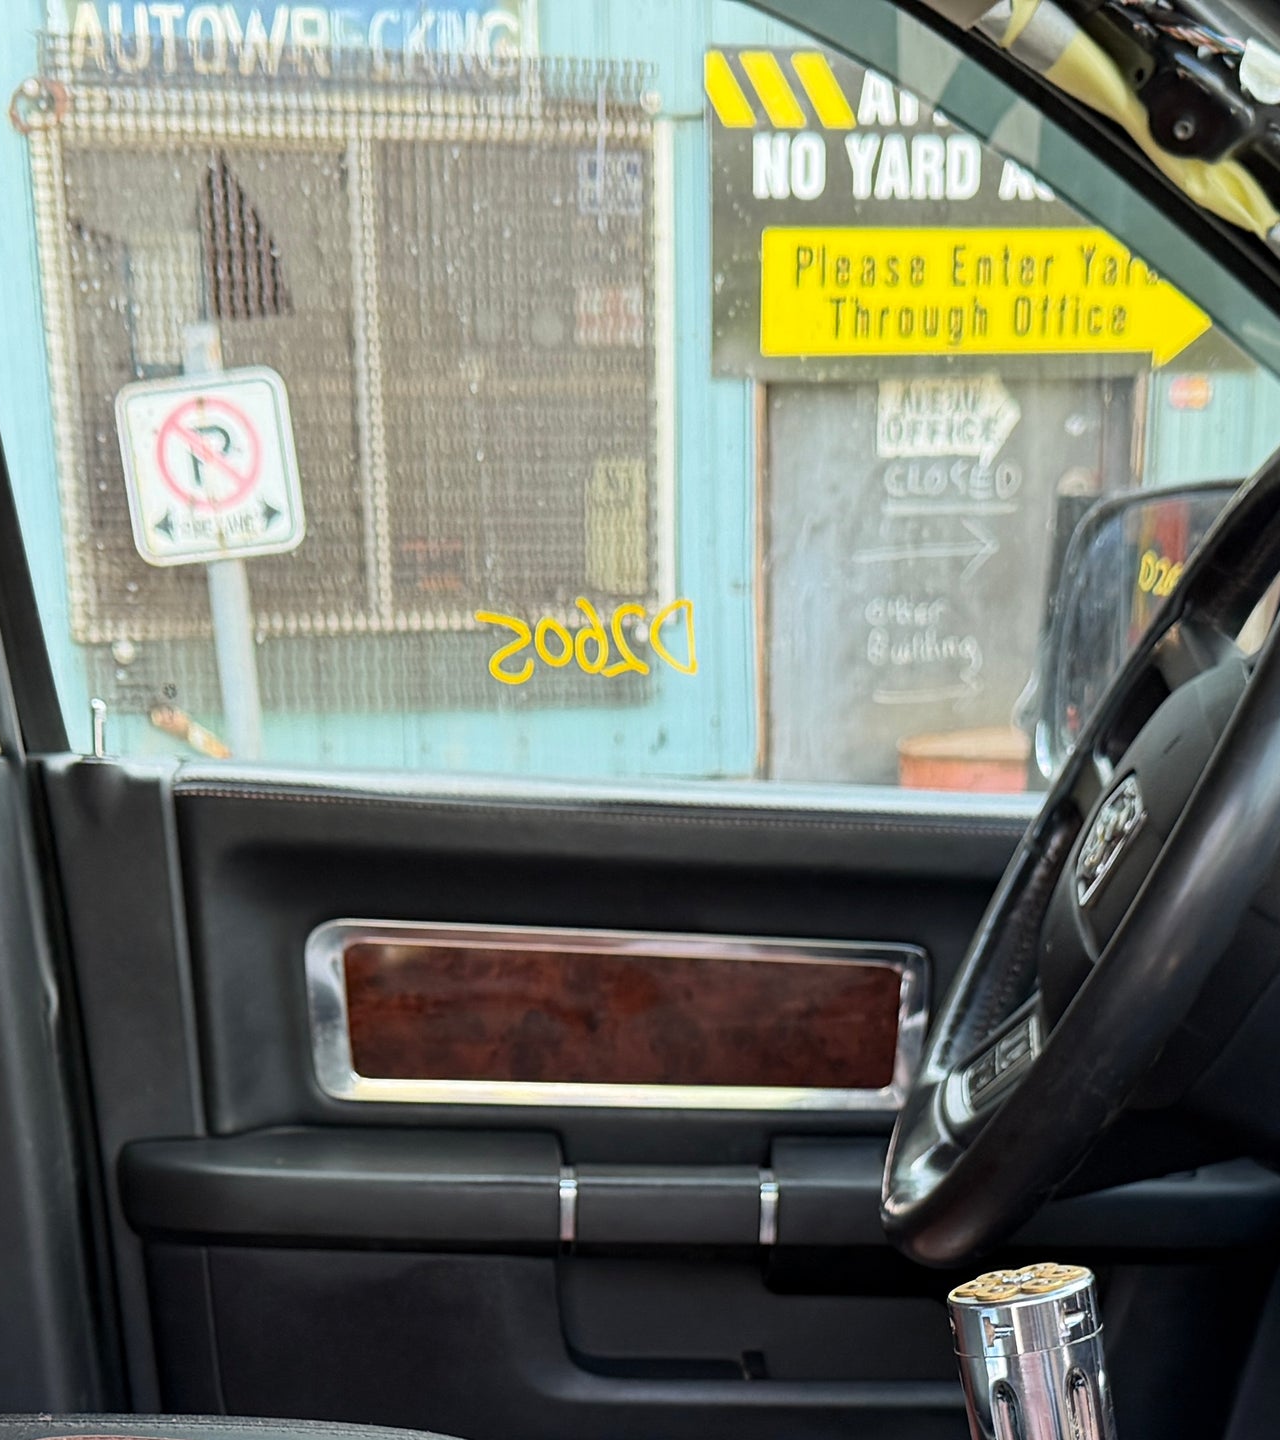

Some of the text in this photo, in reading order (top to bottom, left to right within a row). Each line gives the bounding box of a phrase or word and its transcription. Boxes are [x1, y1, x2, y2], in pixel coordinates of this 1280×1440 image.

[752, 131, 826, 200] NO
[844, 132, 982, 200] YARD
[795, 244, 926, 288] Please
[951, 243, 1054, 287] Enter
[829, 294, 1128, 346] Through Office
[884, 459, 1021, 499] CLOSED
